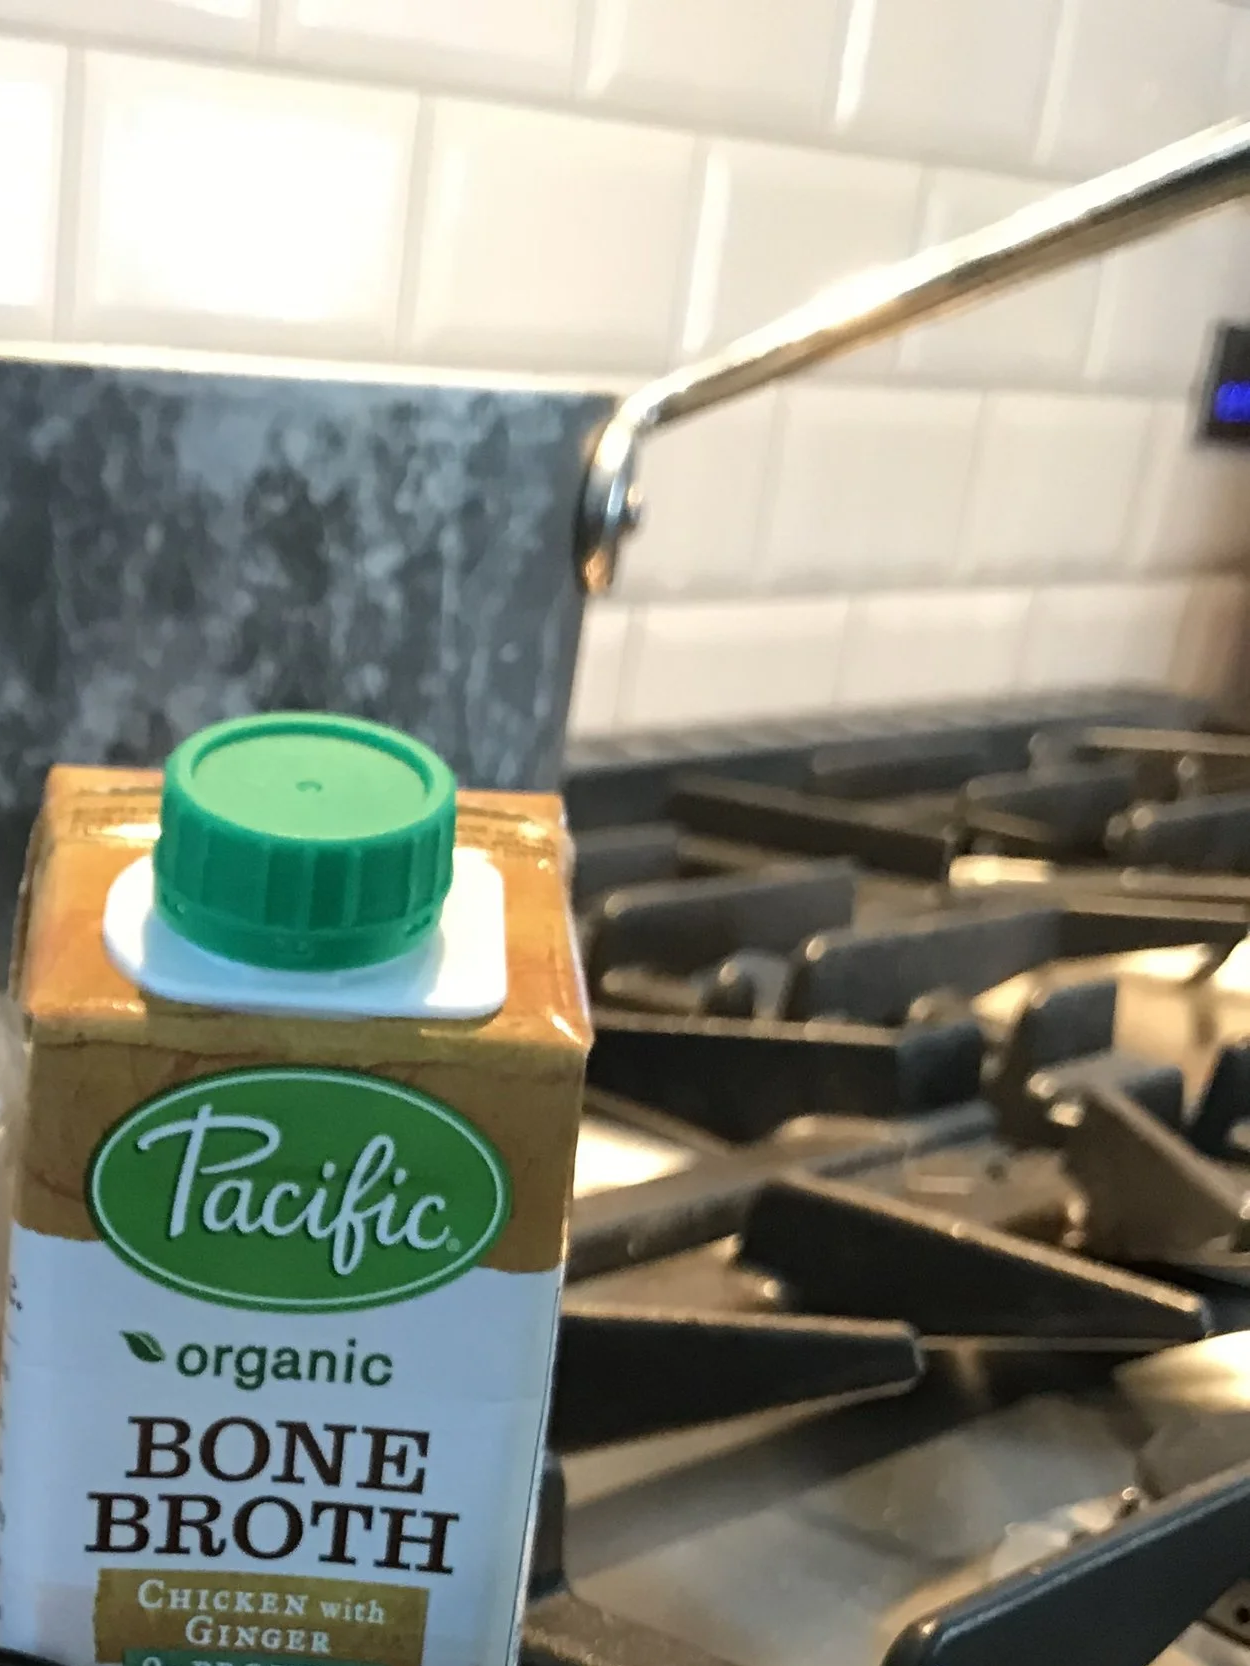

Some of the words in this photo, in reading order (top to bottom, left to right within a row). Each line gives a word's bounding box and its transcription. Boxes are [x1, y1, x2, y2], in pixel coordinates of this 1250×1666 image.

[137, 1103, 450, 1276] Pacific
[175, 1337, 394, 1391] organic
[124, 1416, 432, 1495] BONE
[84, 1492, 461, 1575] BROTH
[137, 1579, 309, 1617] CHICKEN
[319, 1599, 386, 1625] with
[184, 1615, 332, 1654] GINGER
